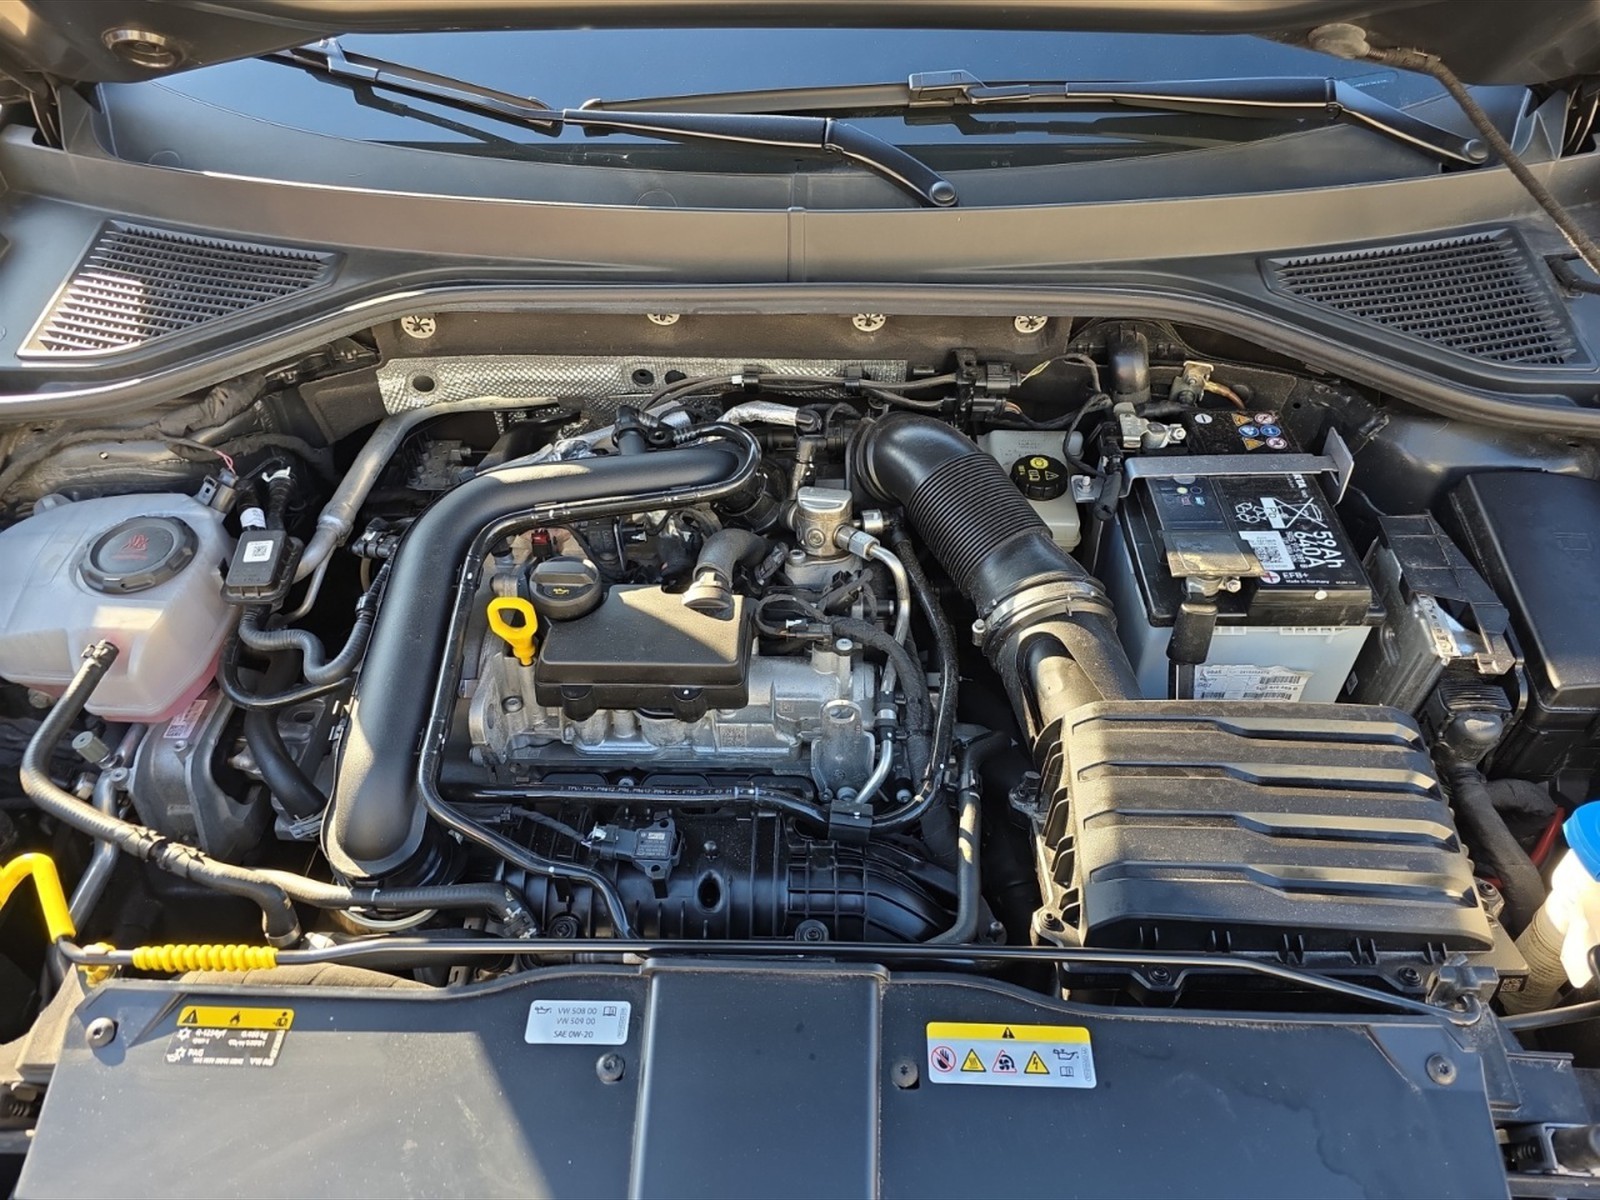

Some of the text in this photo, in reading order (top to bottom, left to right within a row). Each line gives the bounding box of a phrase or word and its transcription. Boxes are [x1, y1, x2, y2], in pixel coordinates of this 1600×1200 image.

[1294, 531, 1326, 568] 640A
[1312, 531, 1345, 568] 59Ah
[558, 1007, 598, 1015] VW 508 00
[556, 1017, 596, 1025] VW 509 00
[568, 1030, 594, 1038] 0W-20
